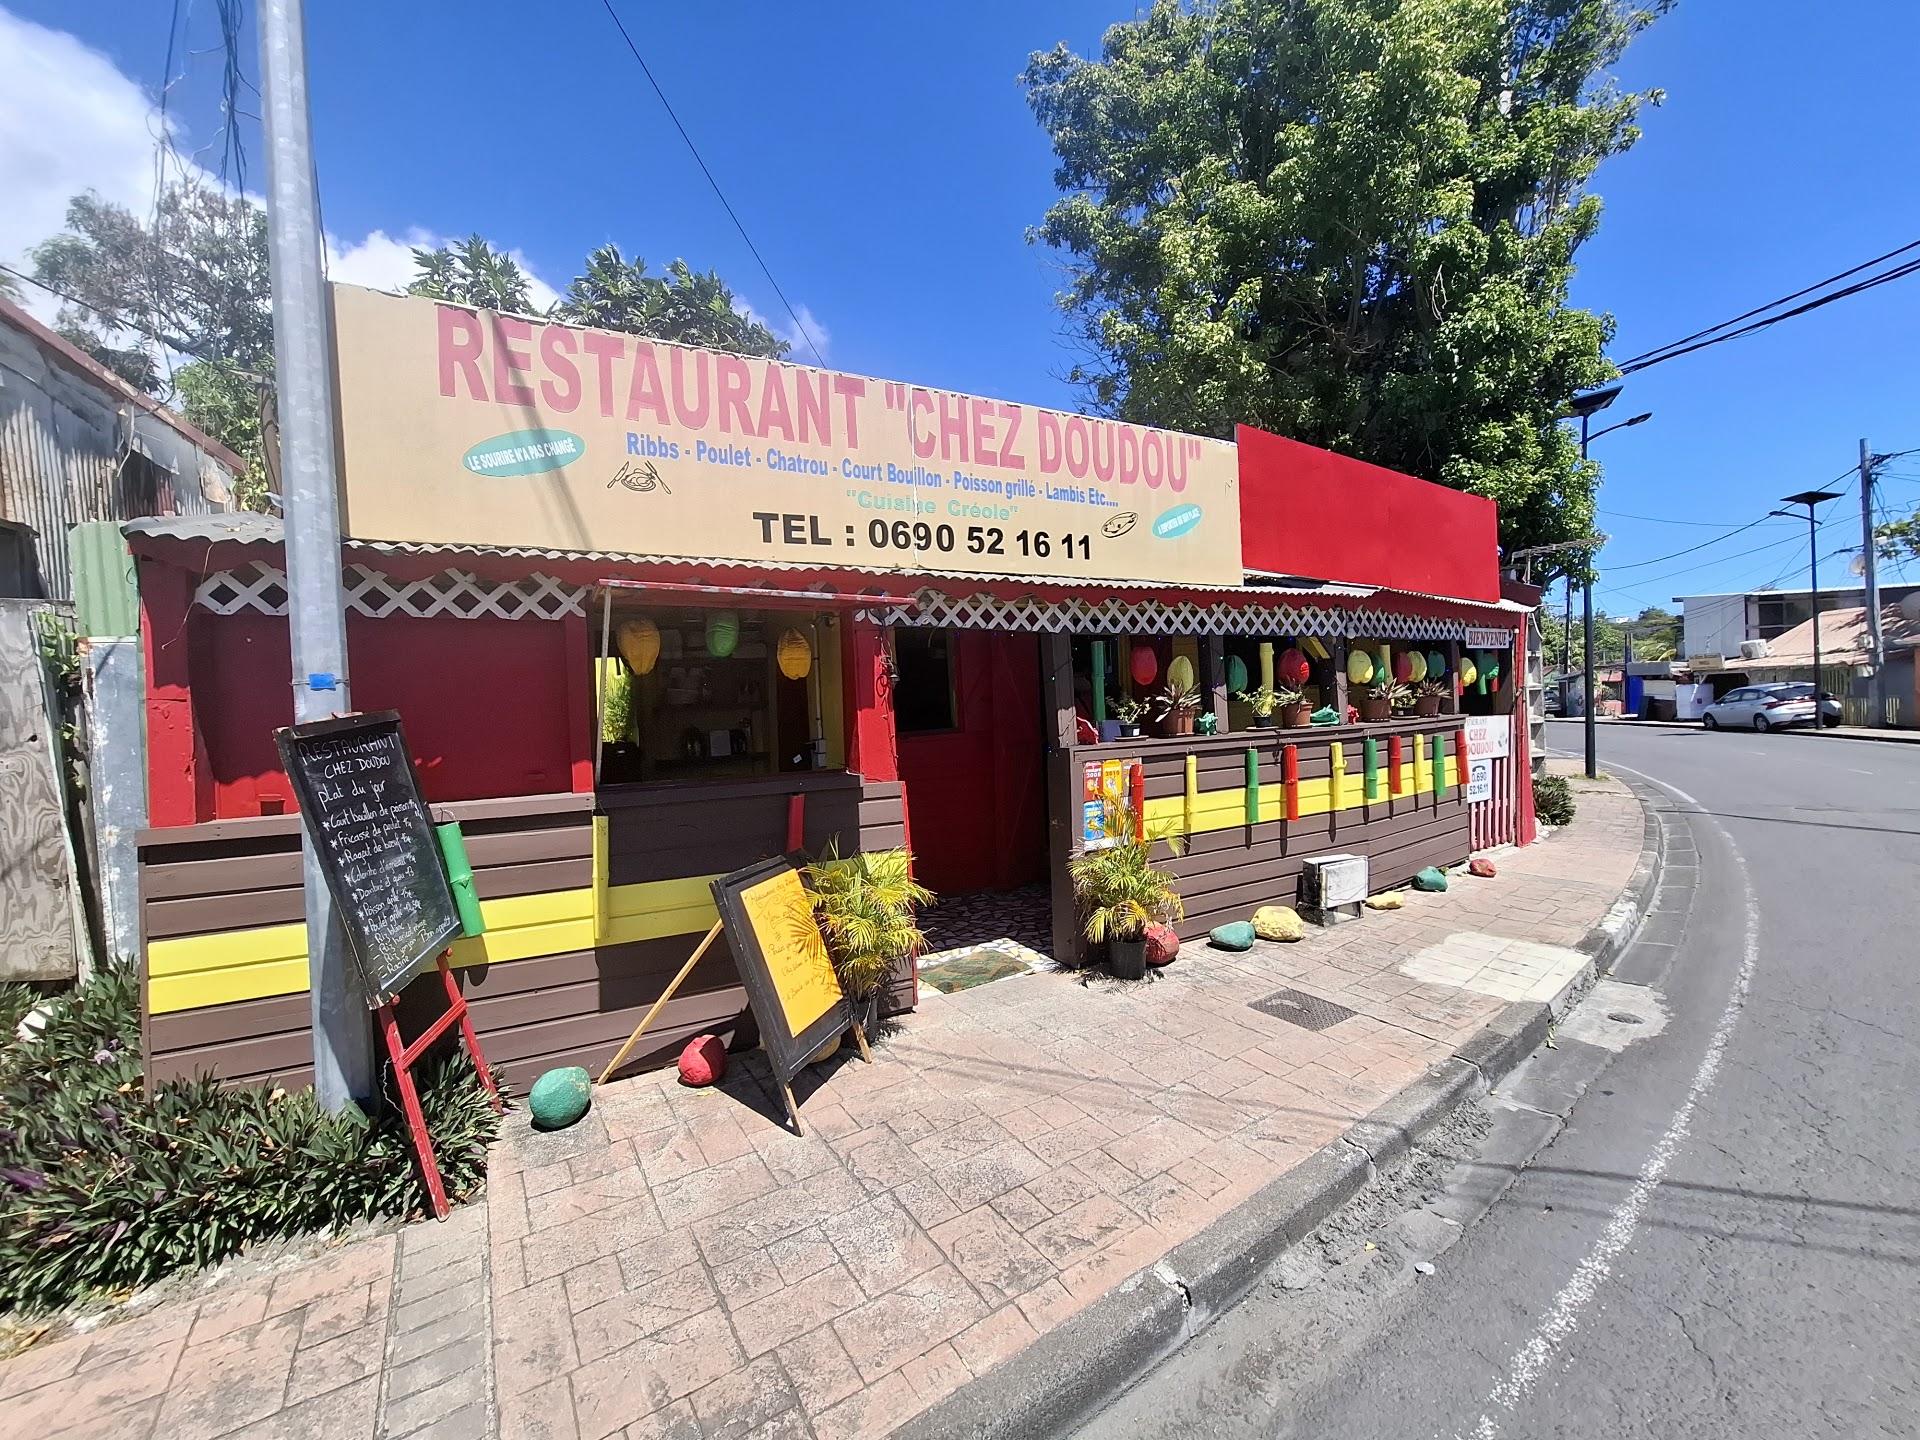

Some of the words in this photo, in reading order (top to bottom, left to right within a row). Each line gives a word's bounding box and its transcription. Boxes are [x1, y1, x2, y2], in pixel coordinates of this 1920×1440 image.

[437, 306, 865, 449] RESTAURANT
[467, 455, 482, 471] LE
[480, 448, 517, 469] SOURIRE
[514, 447, 531, 463] N'A
[527, 442, 545, 460] PAS
[626, 432, 679, 460] Ribbs
[696, 440, 751, 467] Poulet
[767, 448, 828, 476] Chatrou
[842, 458, 883, 482] Court
[887, 463, 942, 488] Bouillon
[954, 471, 1002, 494] Poisson
[1006, 479, 1036, 500] grillé
[1046, 482, 1086, 503] Lambis
[752, 511, 832, 546] TEL
[868, 519, 955, 552] 0690
[967, 526, 1005, 555] 52
[1016, 529, 1051, 558] 16
[1061, 533, 1090, 560] 11
[1468, 631, 1507, 646] BIENVENUE
[1466, 717, 1487, 726] STAURANT
[1469, 728, 1487, 741] CHEZ
[298, 735, 395, 766] RESTAURANT
[324, 760, 354, 778] CHEZ
[355, 755, 391, 771] DOUDOU
[1472, 772, 1487, 783] 0.690
[351, 779, 366, 796] du
[379, 803, 389, 817] de
[372, 822, 382, 837] de
